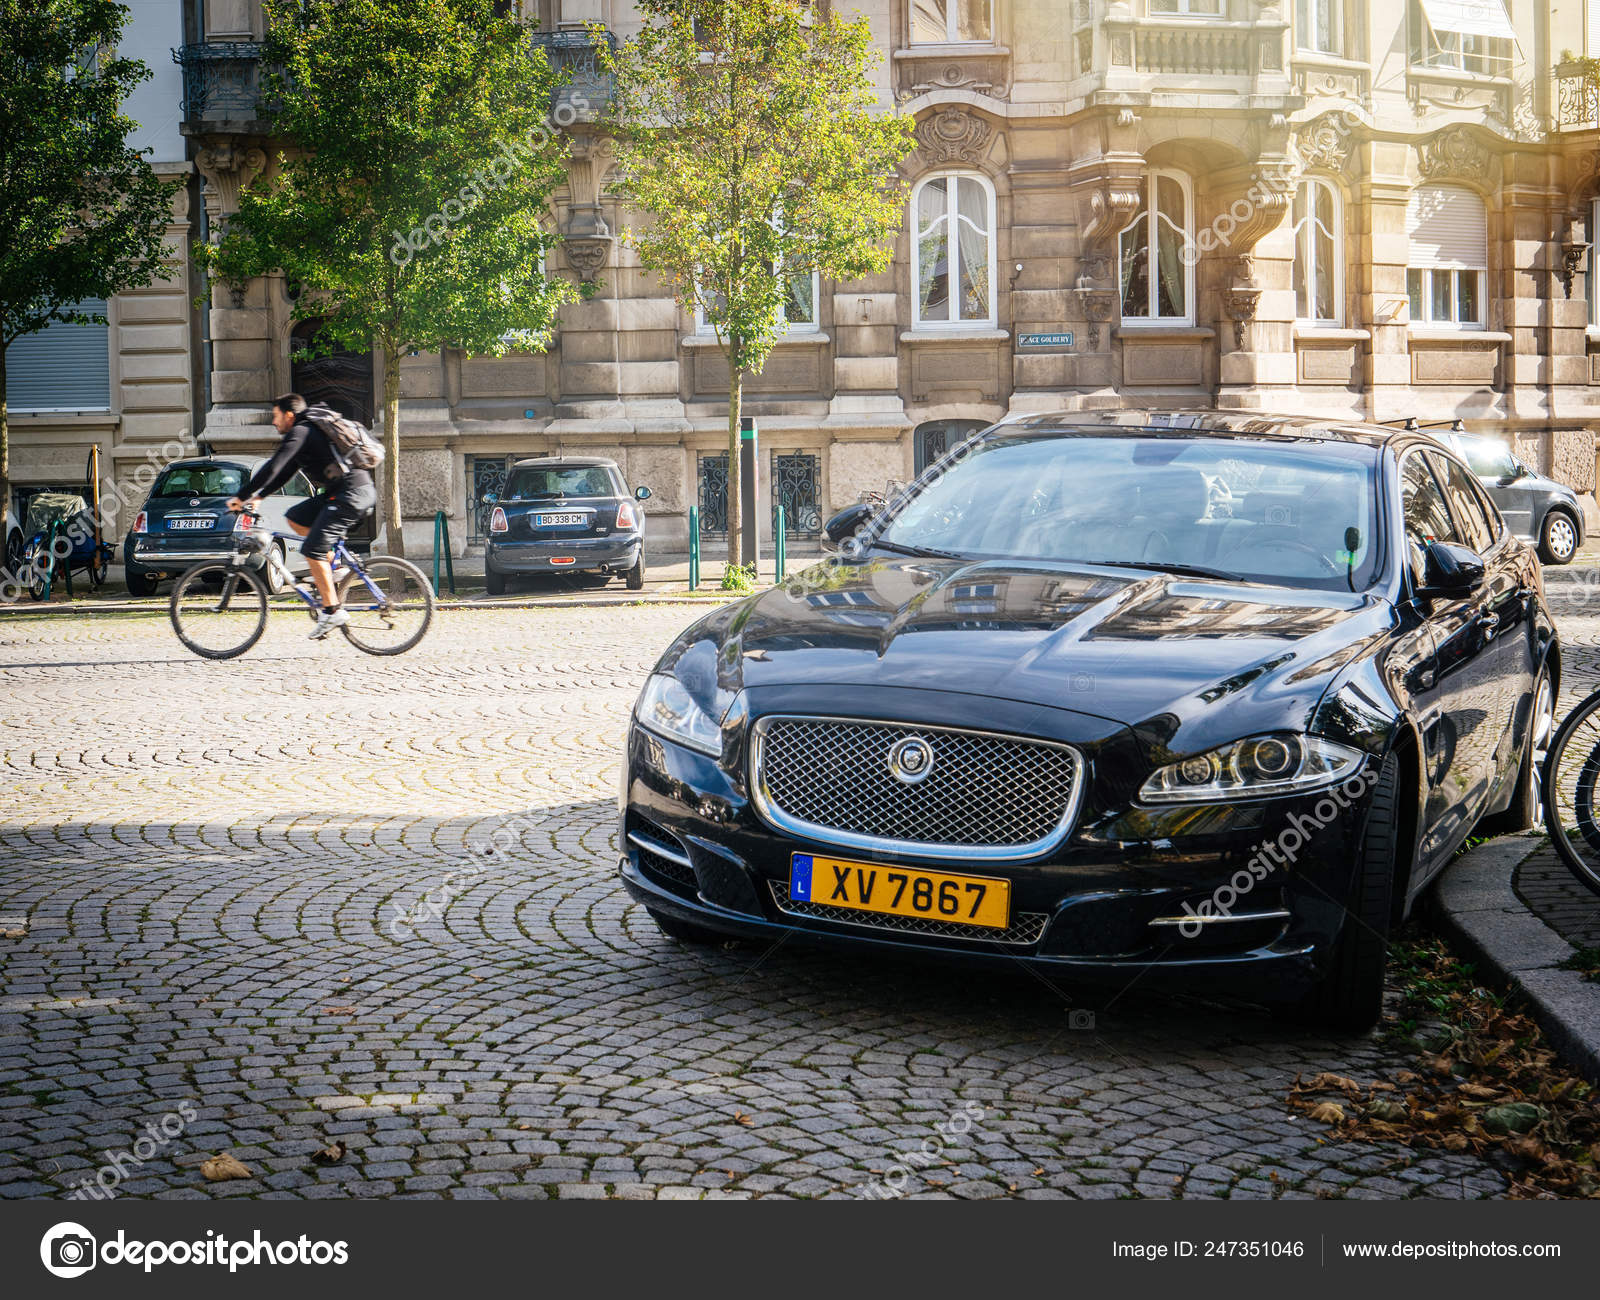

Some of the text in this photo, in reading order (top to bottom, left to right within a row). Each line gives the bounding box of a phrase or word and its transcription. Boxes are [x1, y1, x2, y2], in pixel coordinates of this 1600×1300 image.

[1020, 336, 1039, 344] PACE
[797, 881, 805, 894] L
[831, 865, 987, 918] XV 7867
